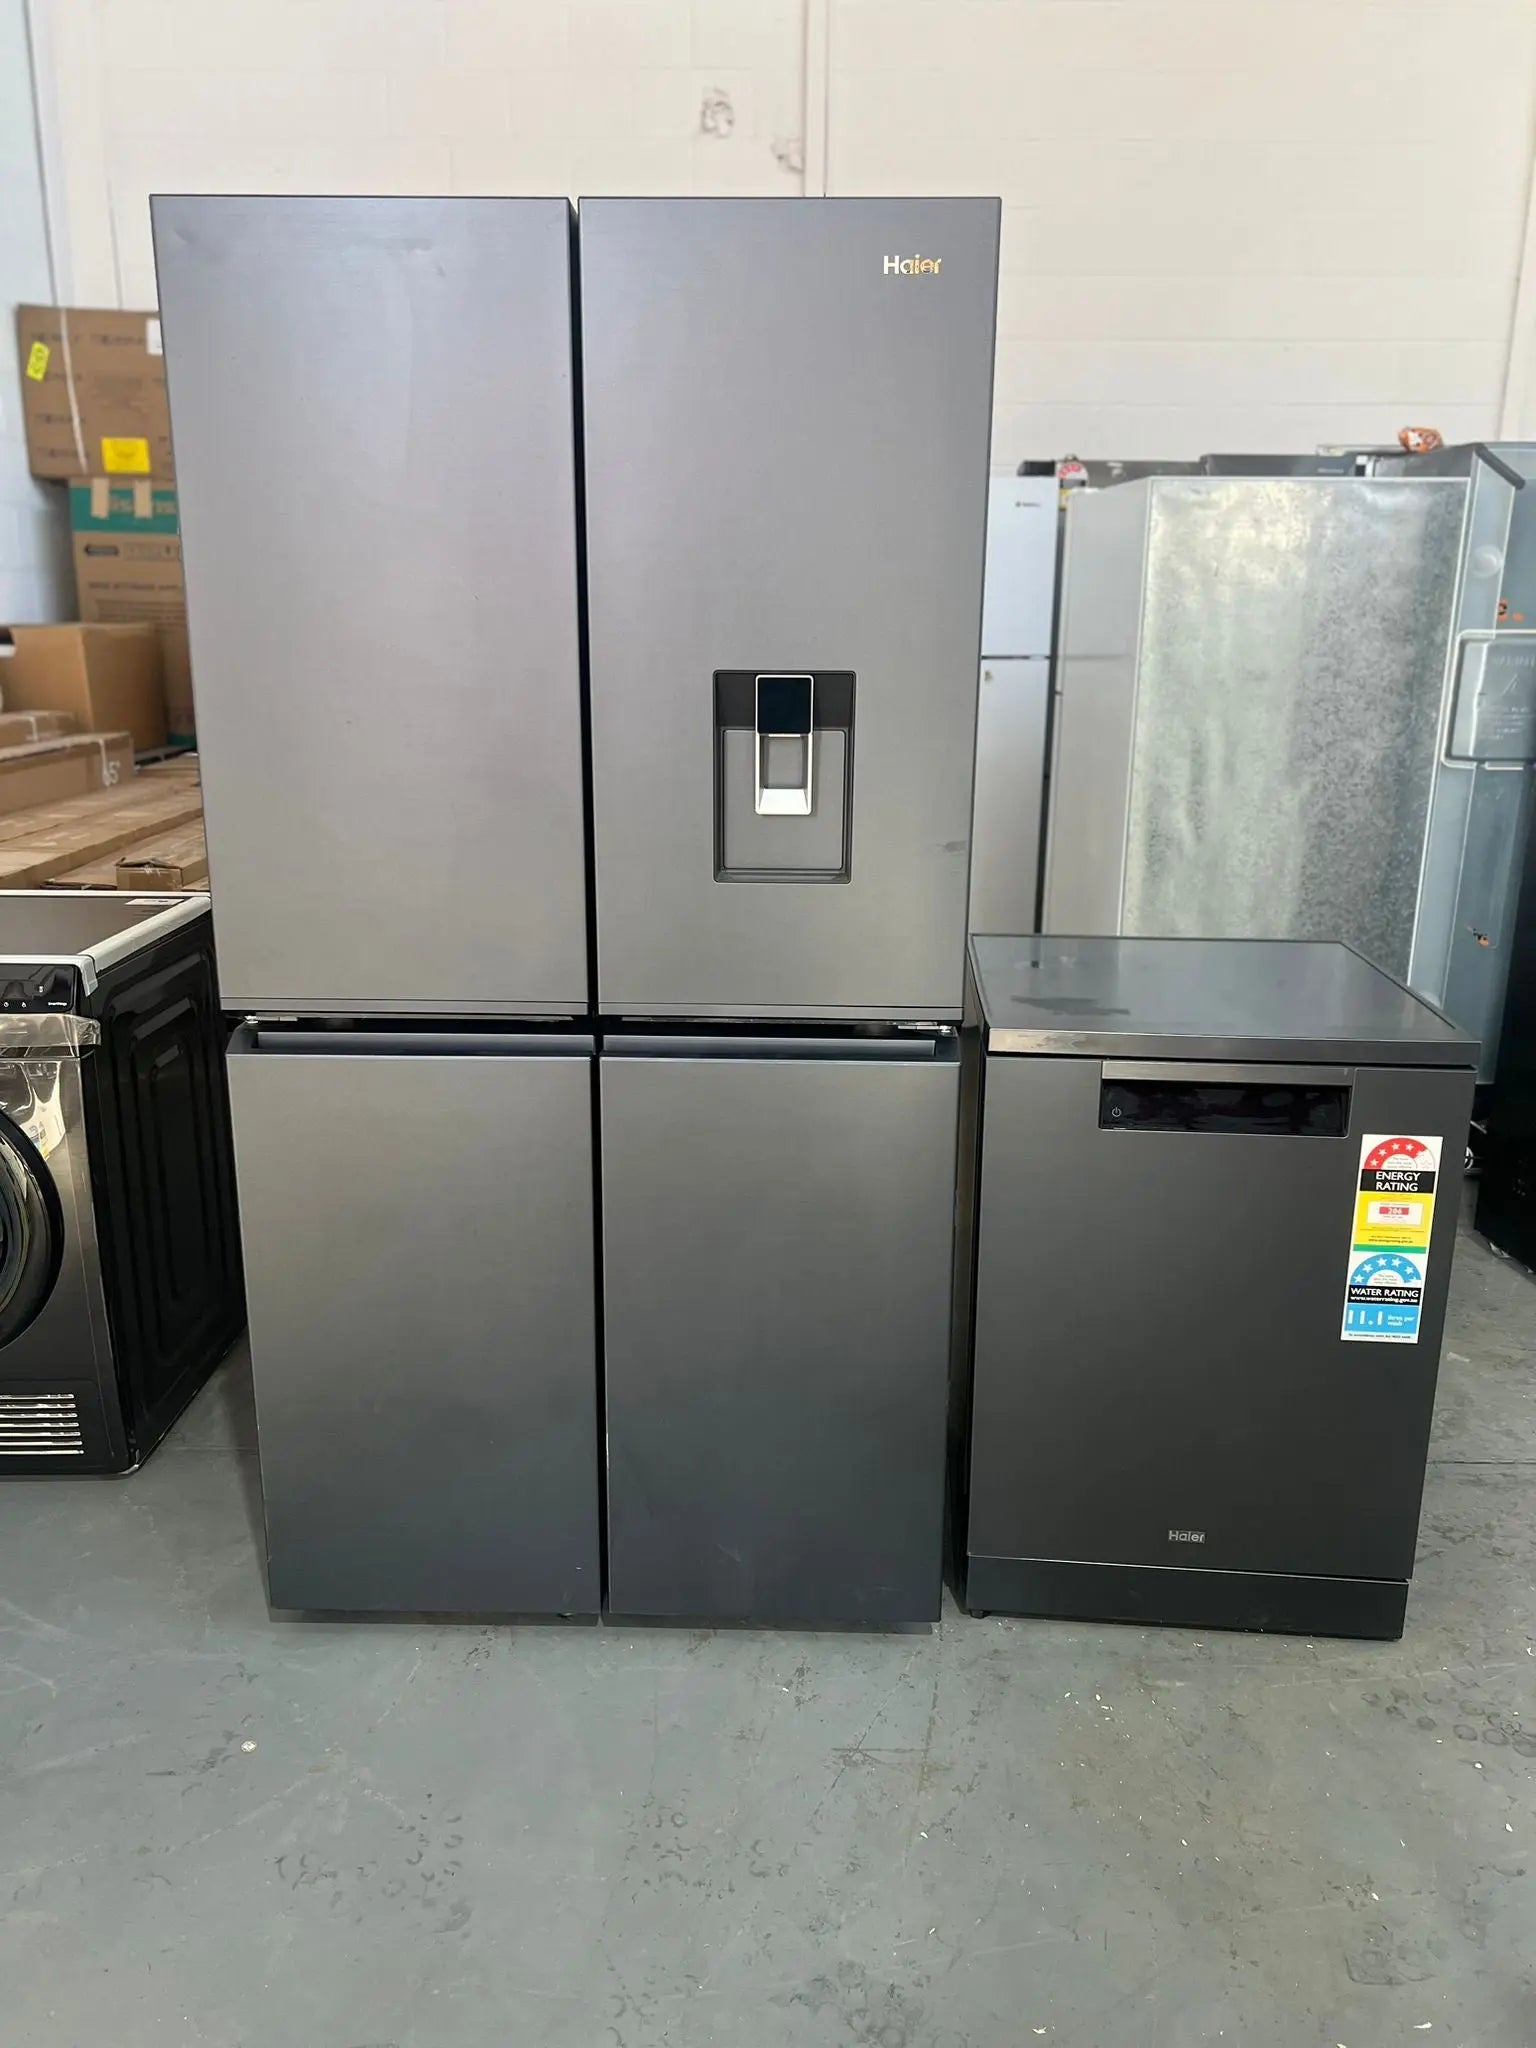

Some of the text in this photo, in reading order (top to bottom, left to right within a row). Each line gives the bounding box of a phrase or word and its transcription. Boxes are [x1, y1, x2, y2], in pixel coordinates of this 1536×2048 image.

[883, 254, 942, 275] Haier
[1375, 1170, 1421, 1181] ENERGY
[1375, 1181, 1419, 1191] RATING
[1350, 1287, 1420, 1298] WATER RATING
[1347, 1309, 1383, 1326] 11.1
[1168, 1530, 1205, 1542] Haier
